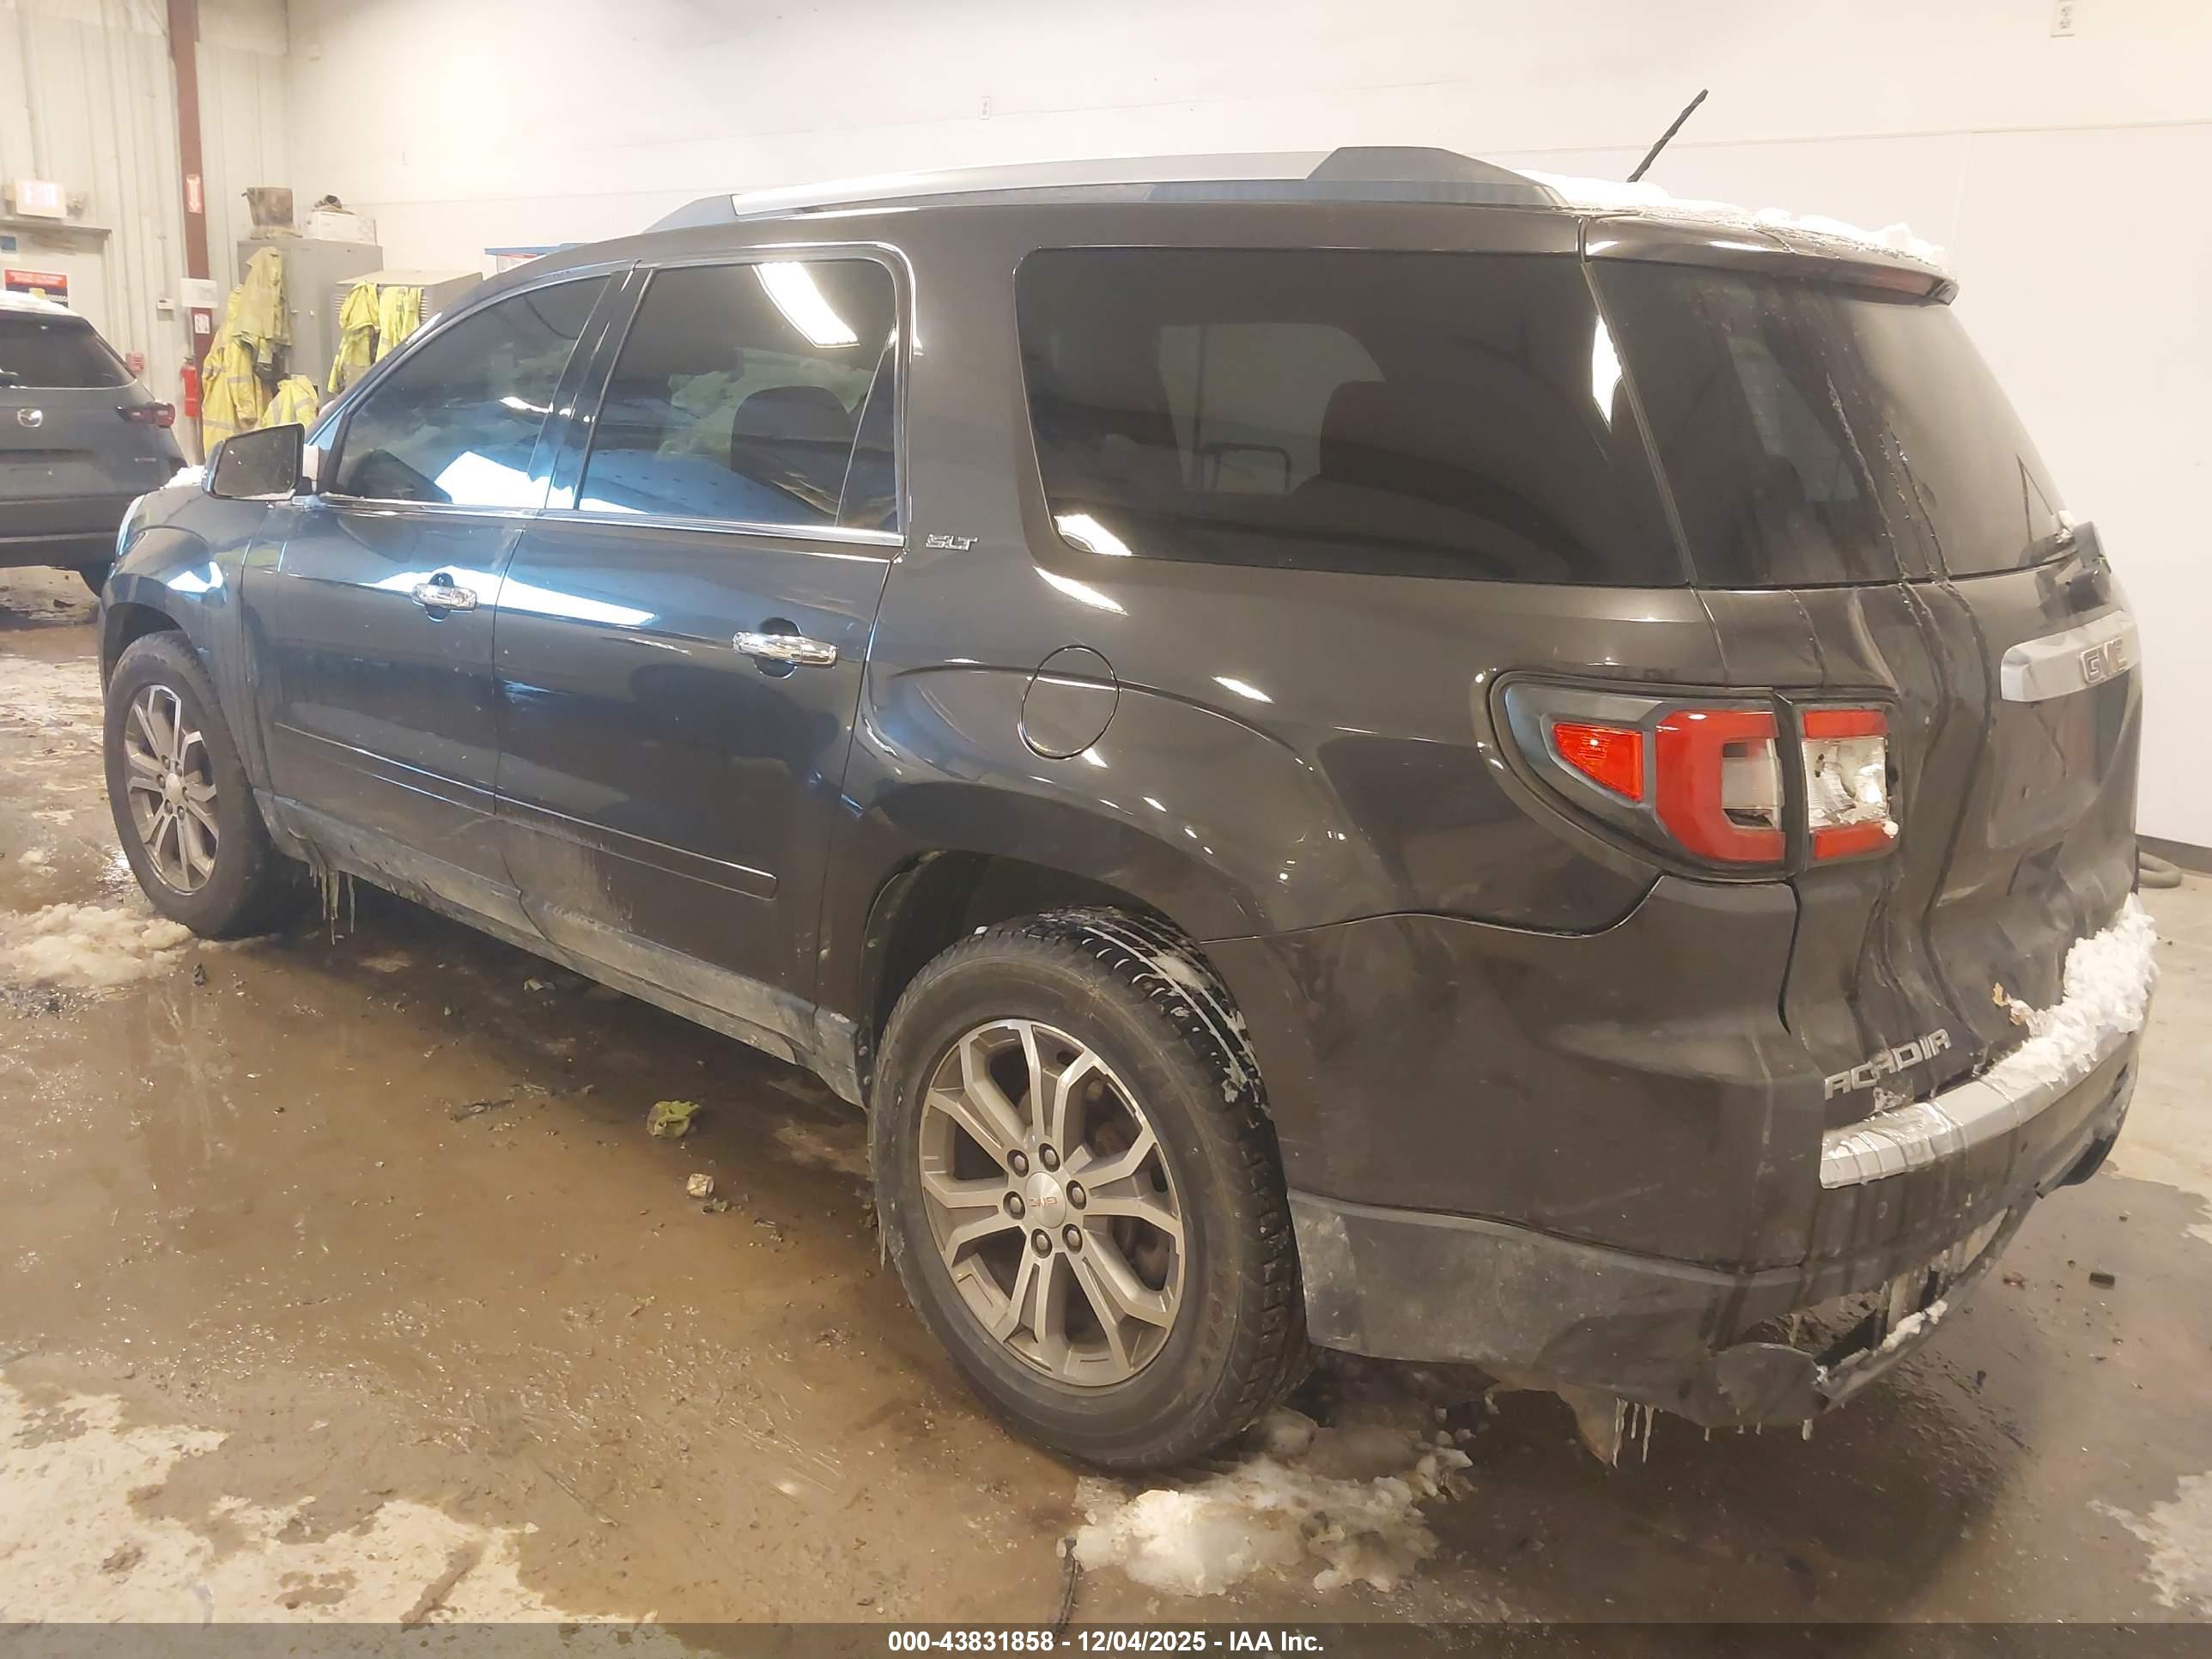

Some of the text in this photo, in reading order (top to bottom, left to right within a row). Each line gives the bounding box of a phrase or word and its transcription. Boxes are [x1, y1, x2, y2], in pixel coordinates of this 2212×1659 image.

[925, 532, 979, 551] SLT
[2080, 637, 2128, 684] GMC
[1824, 1028, 1952, 1101] ACADIA
